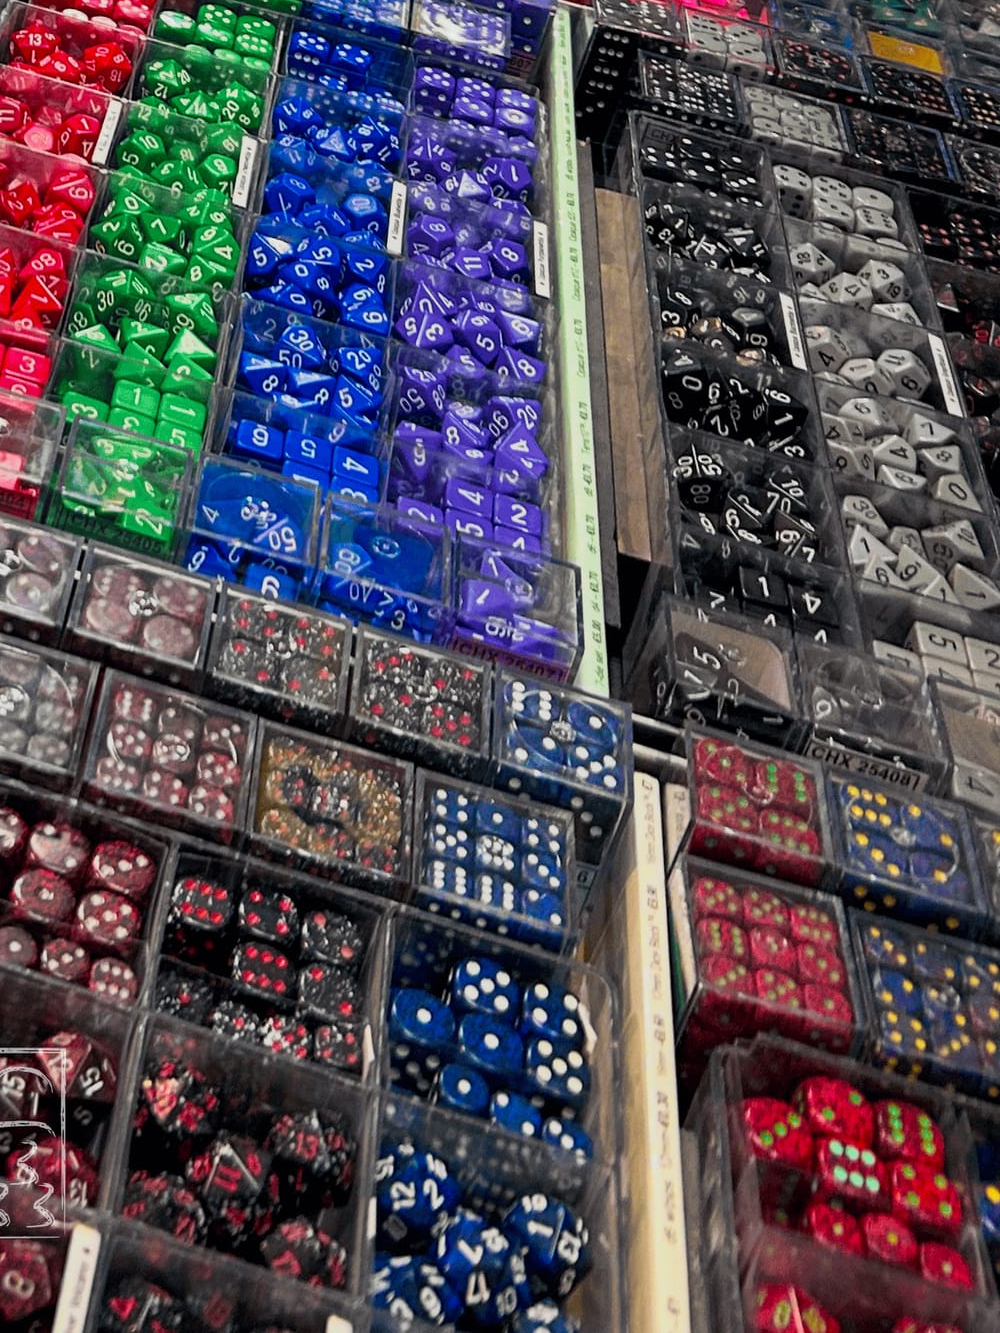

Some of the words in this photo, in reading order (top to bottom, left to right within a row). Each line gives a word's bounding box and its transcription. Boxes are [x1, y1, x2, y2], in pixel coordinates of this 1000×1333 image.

[252, 247, 267, 266] 5
[355, 259, 374, 271] 2
[97, 290, 114, 312] 30
[289, 330, 314, 351] 30
[476, 334, 495, 352] 5
[20, 355, 37, 373] 3
[347, 350, 372, 370] 20
[339, 387, 353, 408] 5
[455, 639, 494, 663] CHX
[811, 747, 851, 769] CHX
